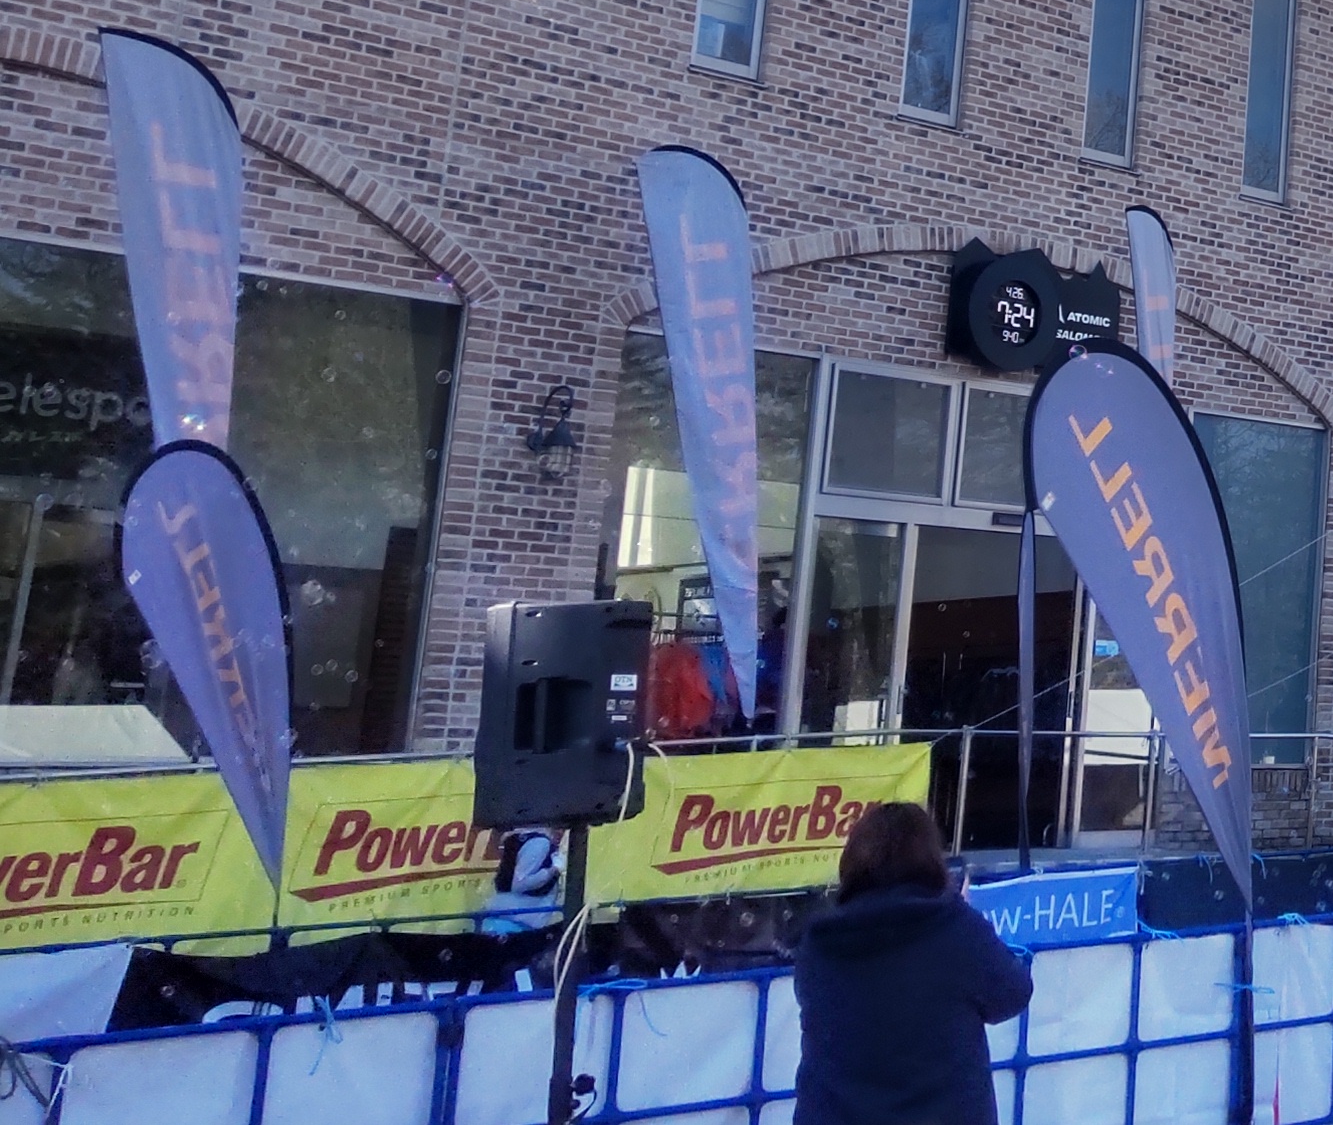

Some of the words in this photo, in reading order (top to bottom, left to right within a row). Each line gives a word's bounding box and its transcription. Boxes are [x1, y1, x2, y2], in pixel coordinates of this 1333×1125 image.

[1067, 311, 1111, 328] ATOMIC
[313, 809, 501, 877] Power
[82, 906, 195, 925] NUTRITION
[983, 889, 1115, 936] W-HALE
